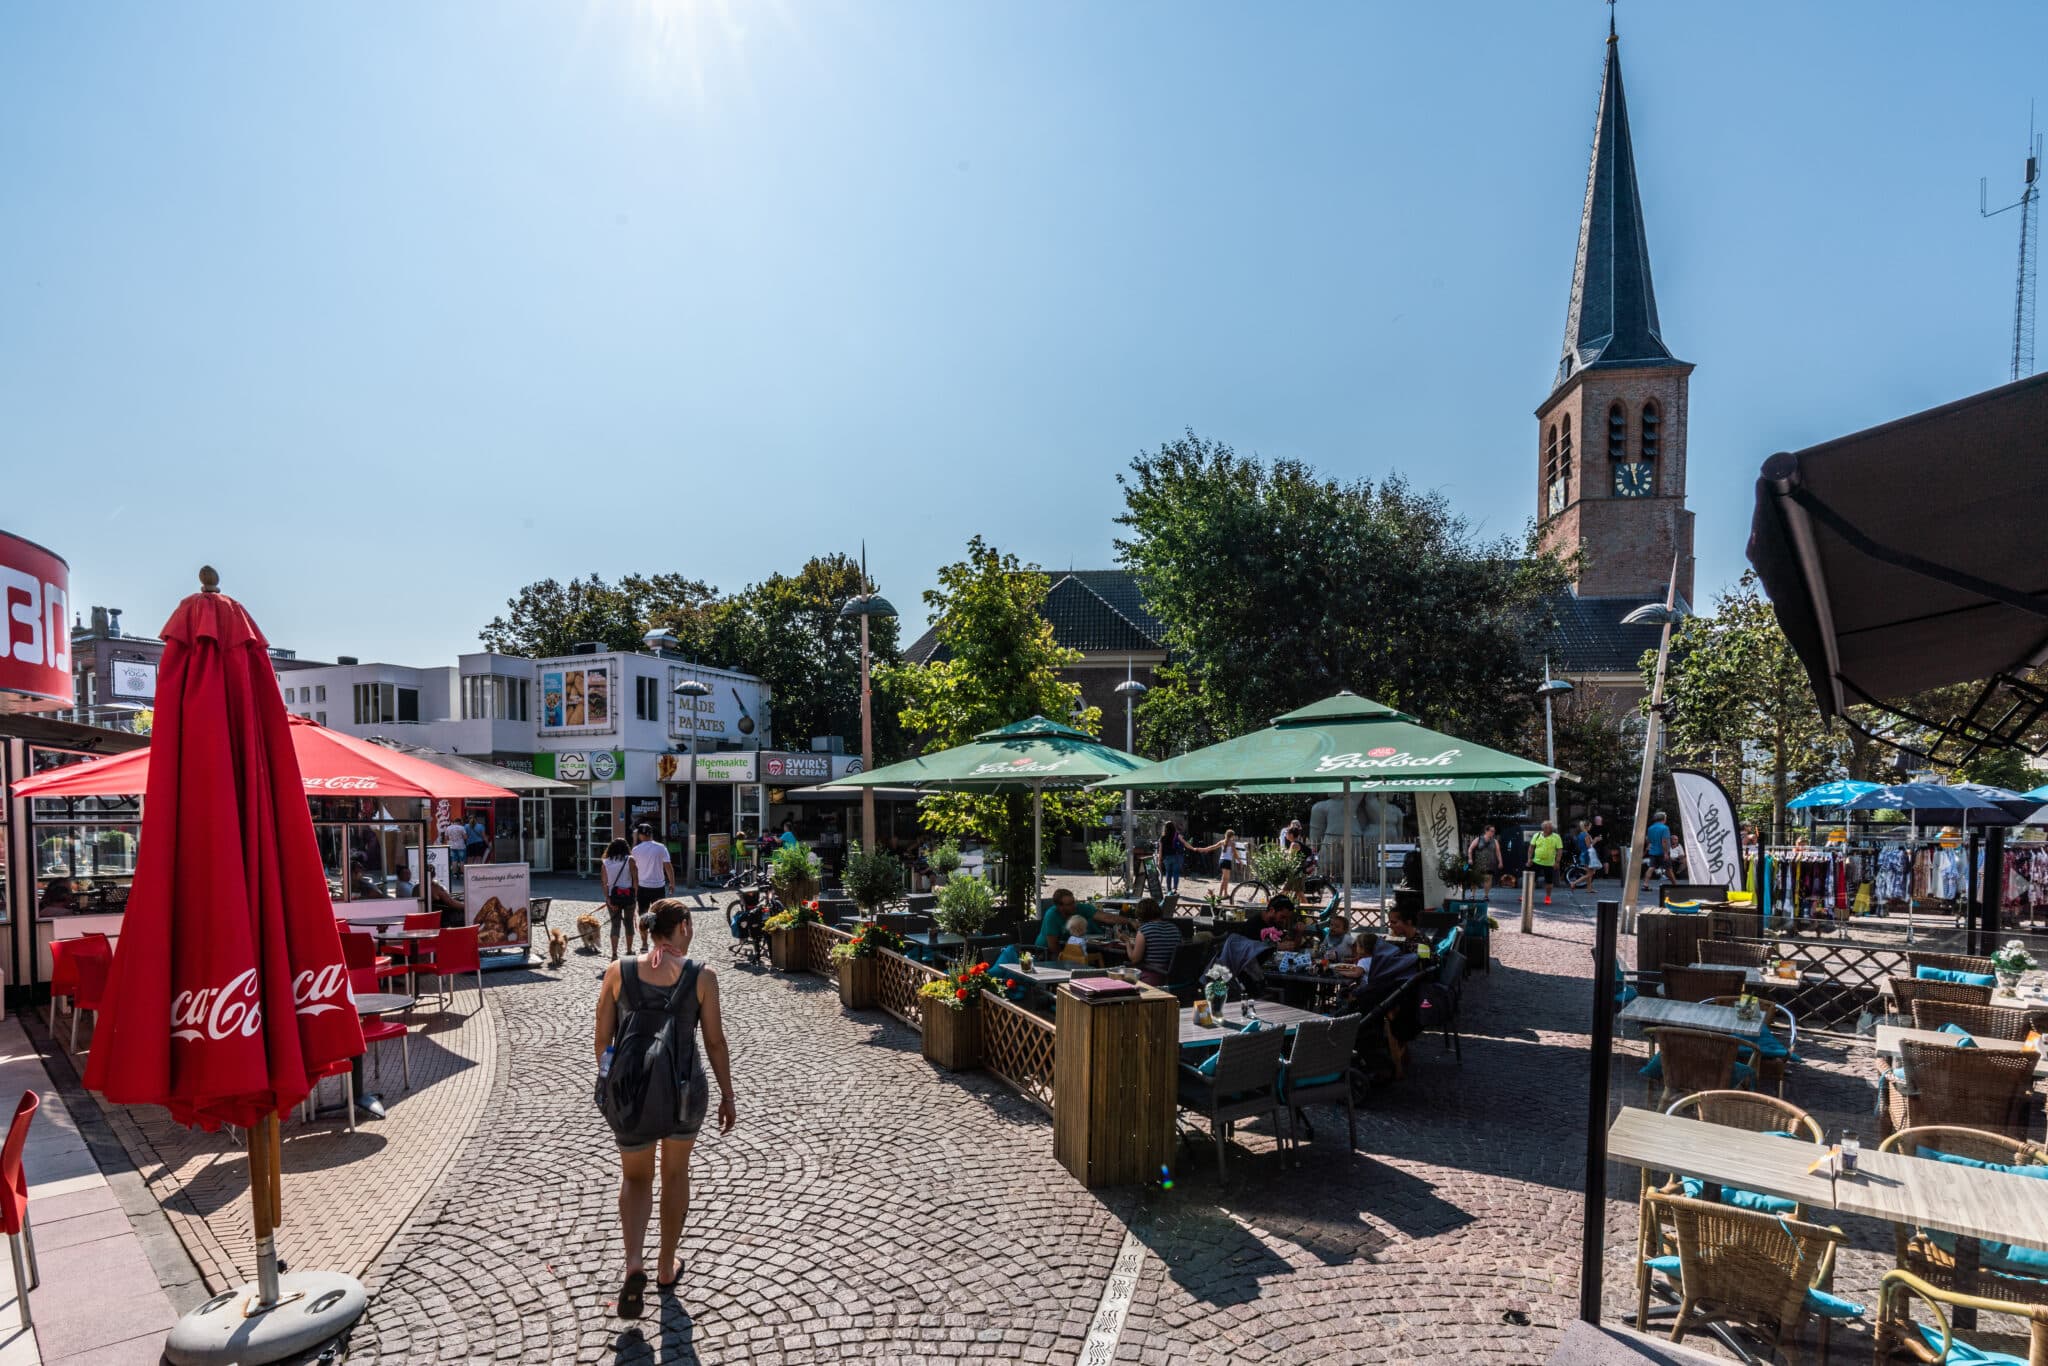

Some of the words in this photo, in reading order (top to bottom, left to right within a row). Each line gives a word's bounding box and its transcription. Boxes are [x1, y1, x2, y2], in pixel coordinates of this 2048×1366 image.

[696, 758, 748, 769] elfgemaakte
[785, 759, 828, 769] SWIRL'S
[1314, 749, 1461, 772] Grolsch
[708, 770, 730, 779] frites
